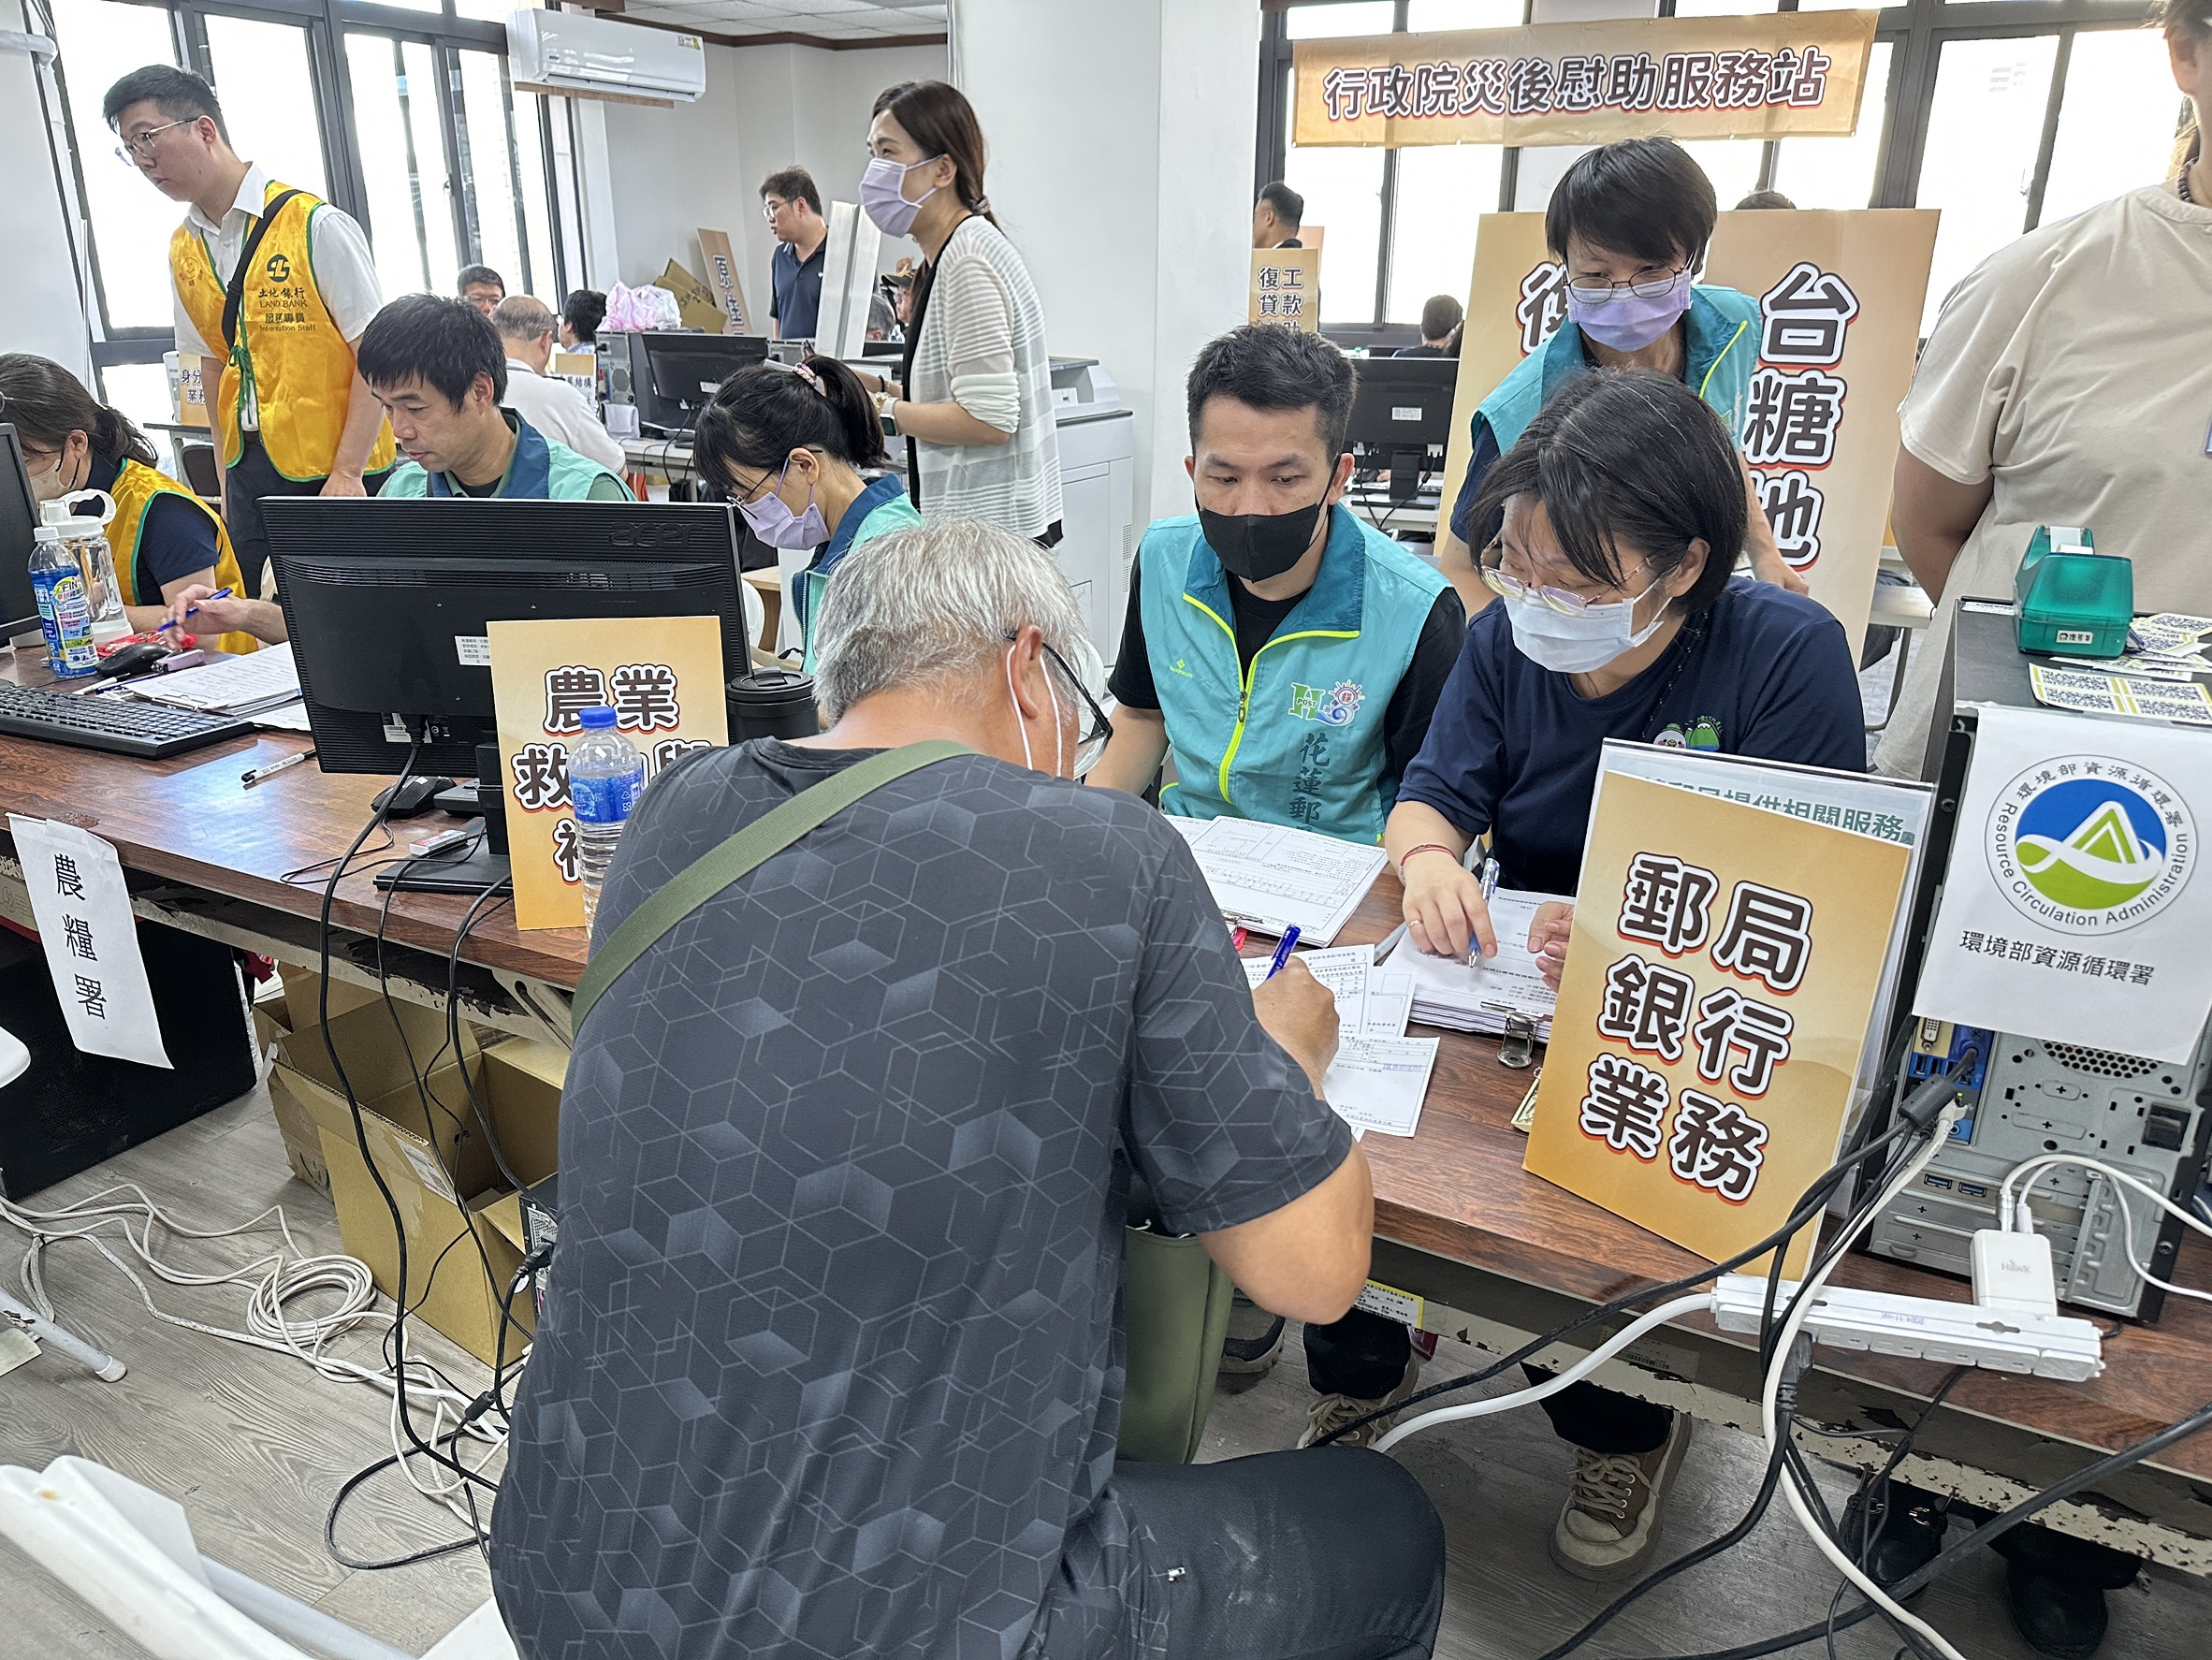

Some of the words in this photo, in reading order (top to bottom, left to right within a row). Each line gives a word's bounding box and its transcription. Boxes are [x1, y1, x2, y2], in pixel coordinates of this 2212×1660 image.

[1324, 47, 1830, 121] 行政院災後慰助服務站
[258, 286, 305, 299] 土地銀行
[259, 299, 281, 309] LAND
[283, 299, 308, 308] BANK
[1258, 266, 1303, 290] 復工
[1258, 292, 1303, 318] 貸款
[298, 323, 316, 331] Staff
[608, 521, 704, 547] acer
[543, 664, 680, 737] 農業
[1297, 697, 1317, 708] POST
[1288, 732, 1331, 833] 花蓮郵
[2016, 761, 2184, 828] 環境部資源循環署
[1994, 801, 2019, 879] Resource
[2012, 881, 2099, 926] Circulation
[2104, 833, 2189, 925] Administration
[53, 852, 108, 1020] 農糧署
[1617, 852, 1813, 996] 郵局
[1958, 930, 2155, 986] 環境部資源循環署
[1596, 954, 1795, 1099] 銀行
[1579, 1052, 1770, 1207] 業務
